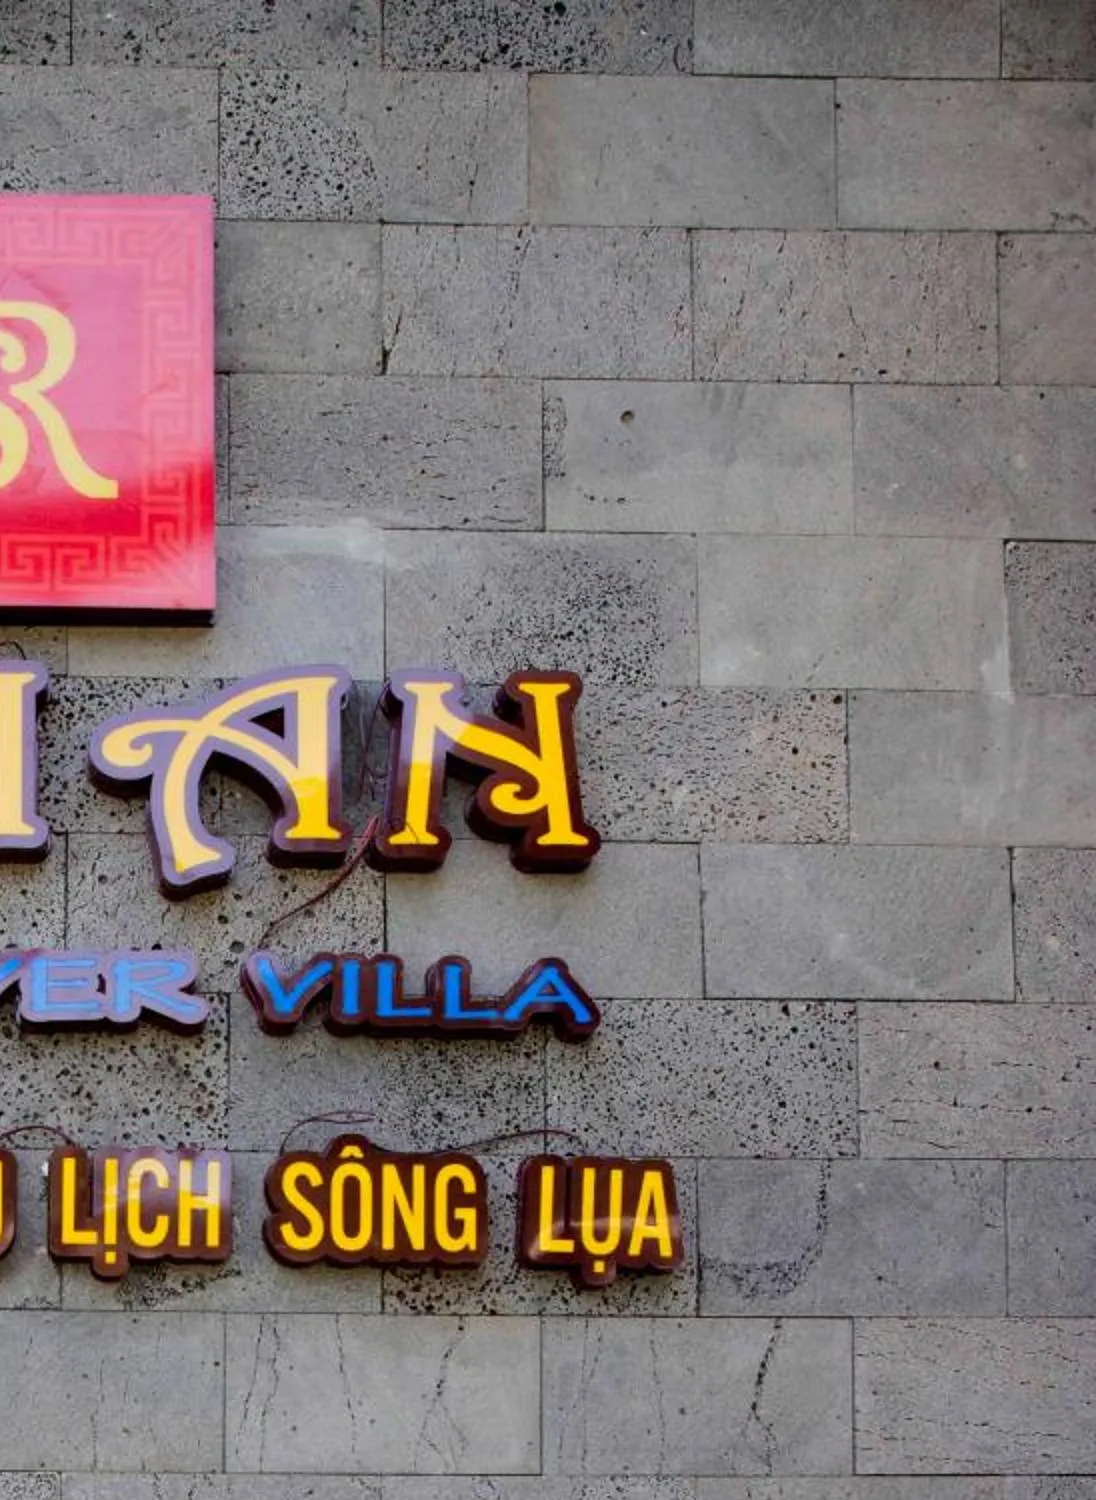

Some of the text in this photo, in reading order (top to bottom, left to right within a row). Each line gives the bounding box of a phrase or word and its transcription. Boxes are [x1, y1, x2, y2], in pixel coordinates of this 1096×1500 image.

[100, 674, 590, 874] AN
[254, 958, 594, 1025] VILLA
[59, 1155, 223, 1266] LỊCH
[278, 1144, 479, 1253] SÔNG
[538, 1163, 675, 1275] LỤA
